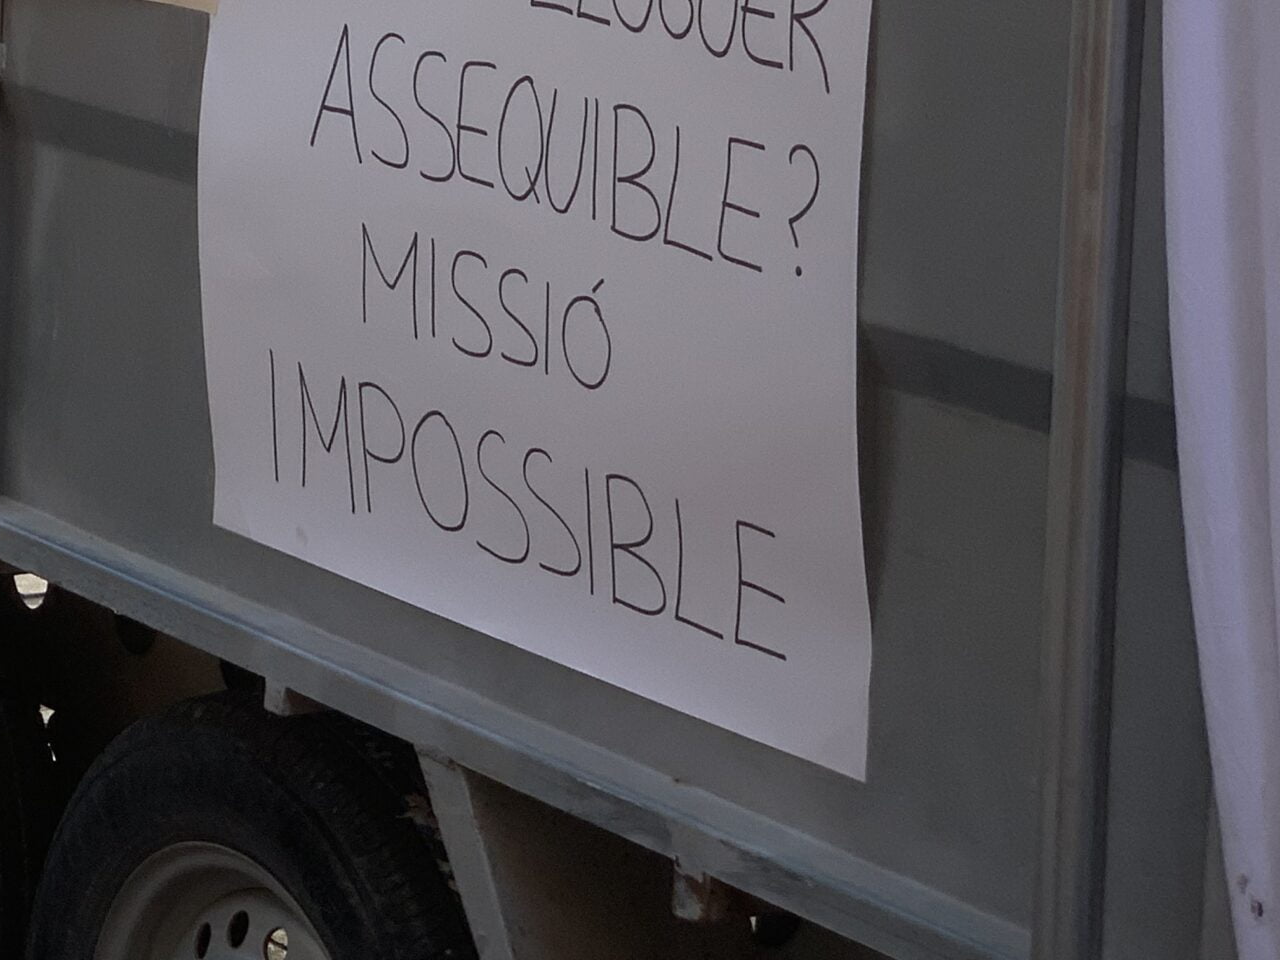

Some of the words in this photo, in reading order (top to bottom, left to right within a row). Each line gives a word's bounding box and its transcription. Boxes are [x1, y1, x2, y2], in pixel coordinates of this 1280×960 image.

[309, 23, 822, 278] ASSEQUIBLE?
[361, 222, 612, 391] MISSIÓ
[269, 348, 789, 662] IMPOSSIBLE
